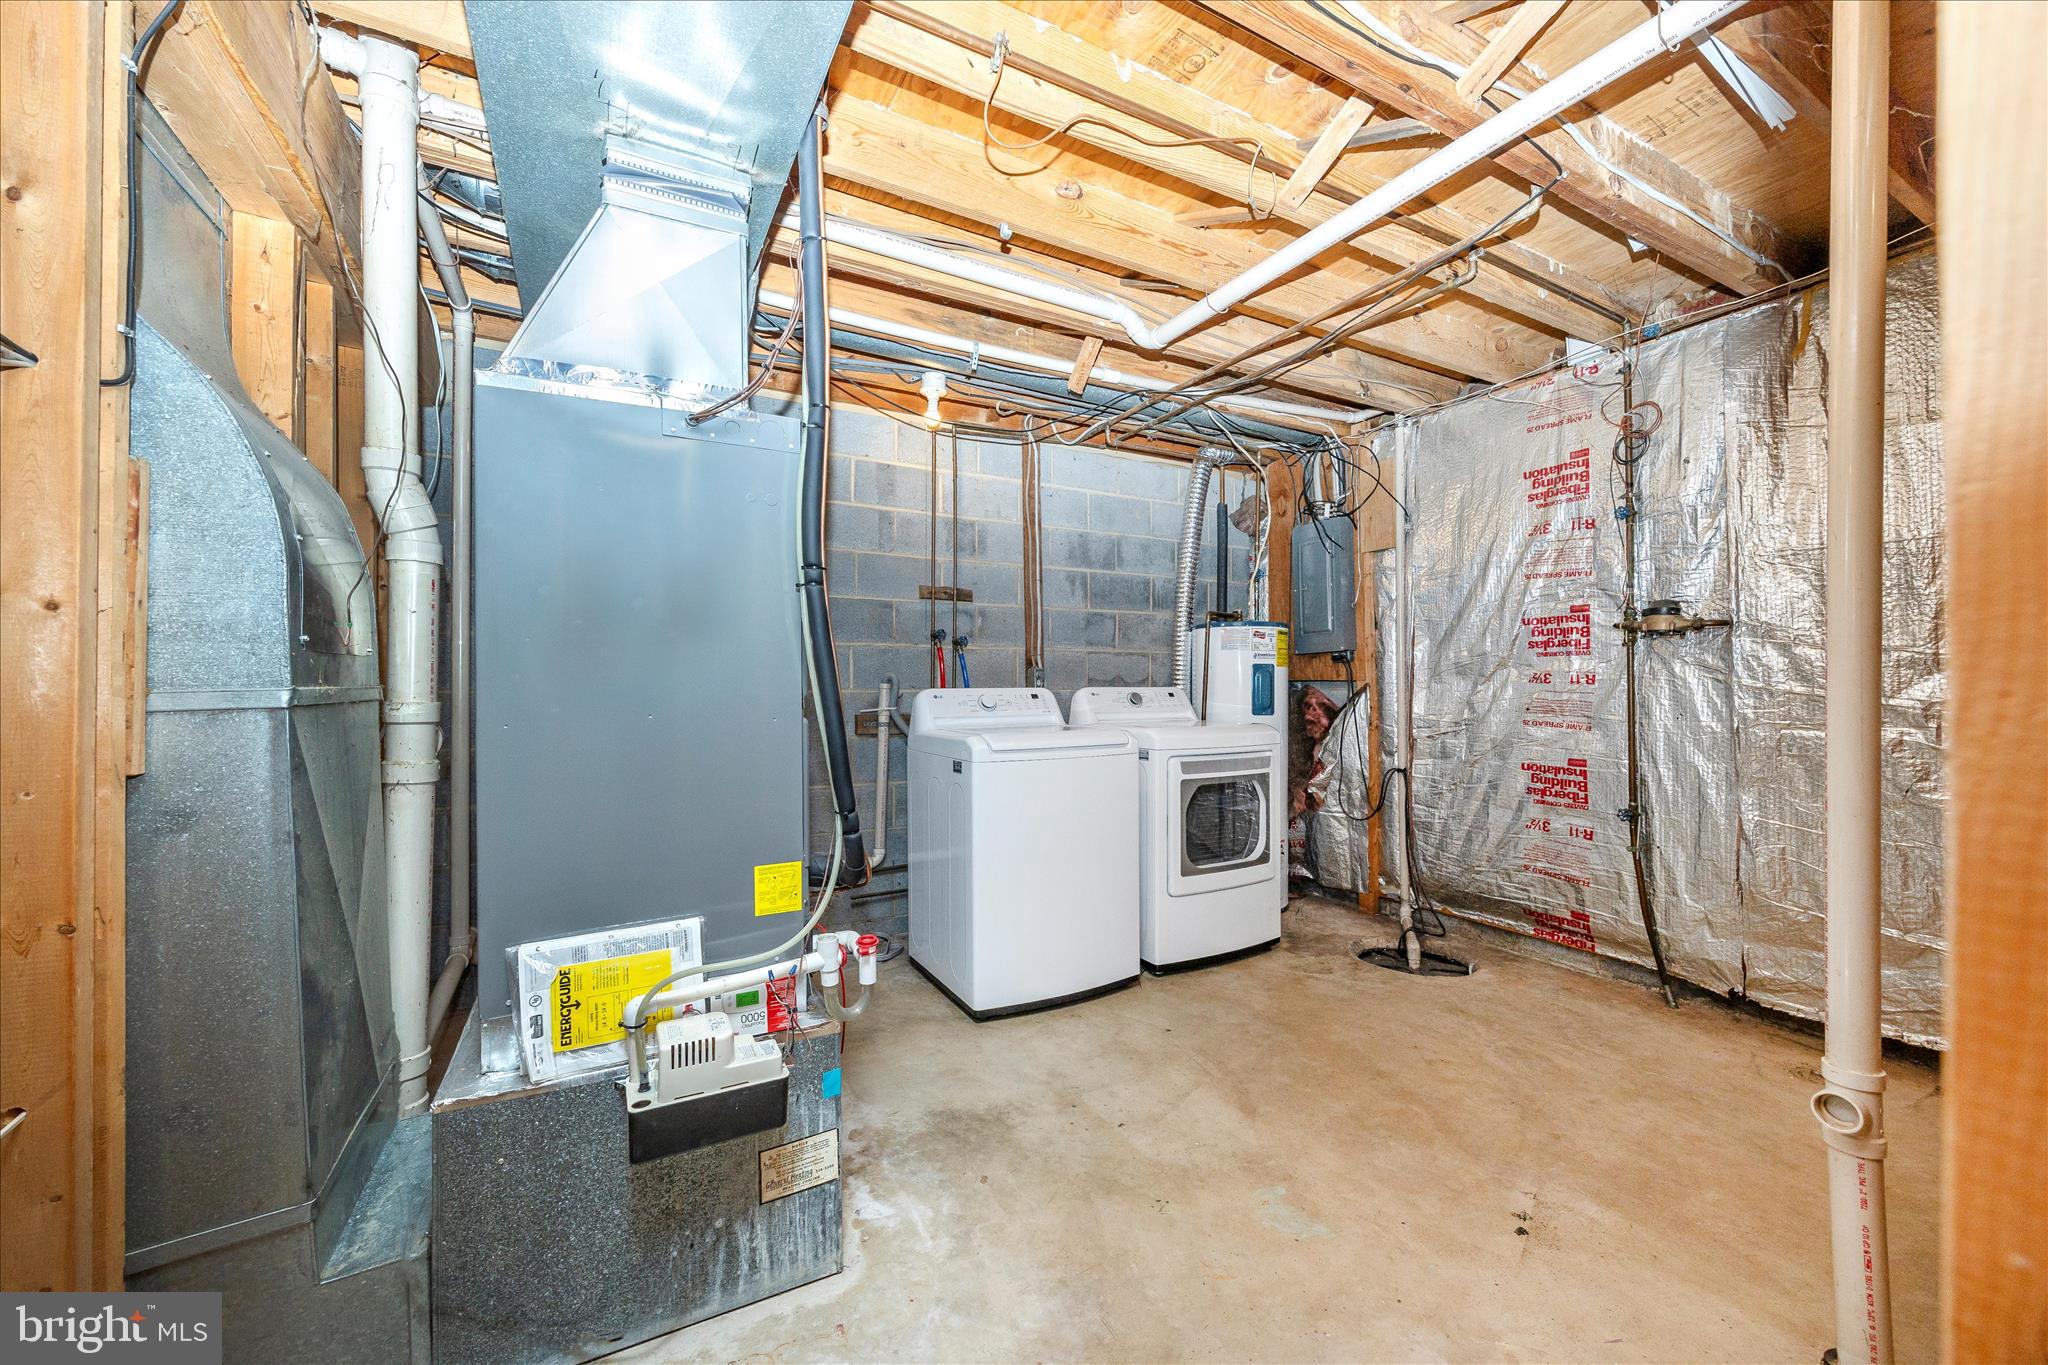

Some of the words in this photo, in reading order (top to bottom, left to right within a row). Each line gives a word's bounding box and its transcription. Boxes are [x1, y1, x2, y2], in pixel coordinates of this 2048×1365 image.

[1535, 419, 1564, 433] SPREAD
[1523, 458, 1590, 481] Insulation
[1532, 470, 1590, 490] Building
[1527, 483, 1590, 503] Fiberglas
[1571, 517, 1596, 532] R-11
[1522, 613, 1590, 628] Insulation
[1531, 625, 1591, 639] Building
[1527, 637, 1591, 651] Fiberglas
[1569, 673, 1596, 686] R-11
[1531, 719, 1564, 729] SPREAD
[1521, 762, 1588, 780] Insulation
[1531, 772, 1588, 793] Building
[1526, 786, 1589, 805] Fiberglas
[1569, 826, 1594, 842] R-11
[740, 1011, 766, 1024] 5000
